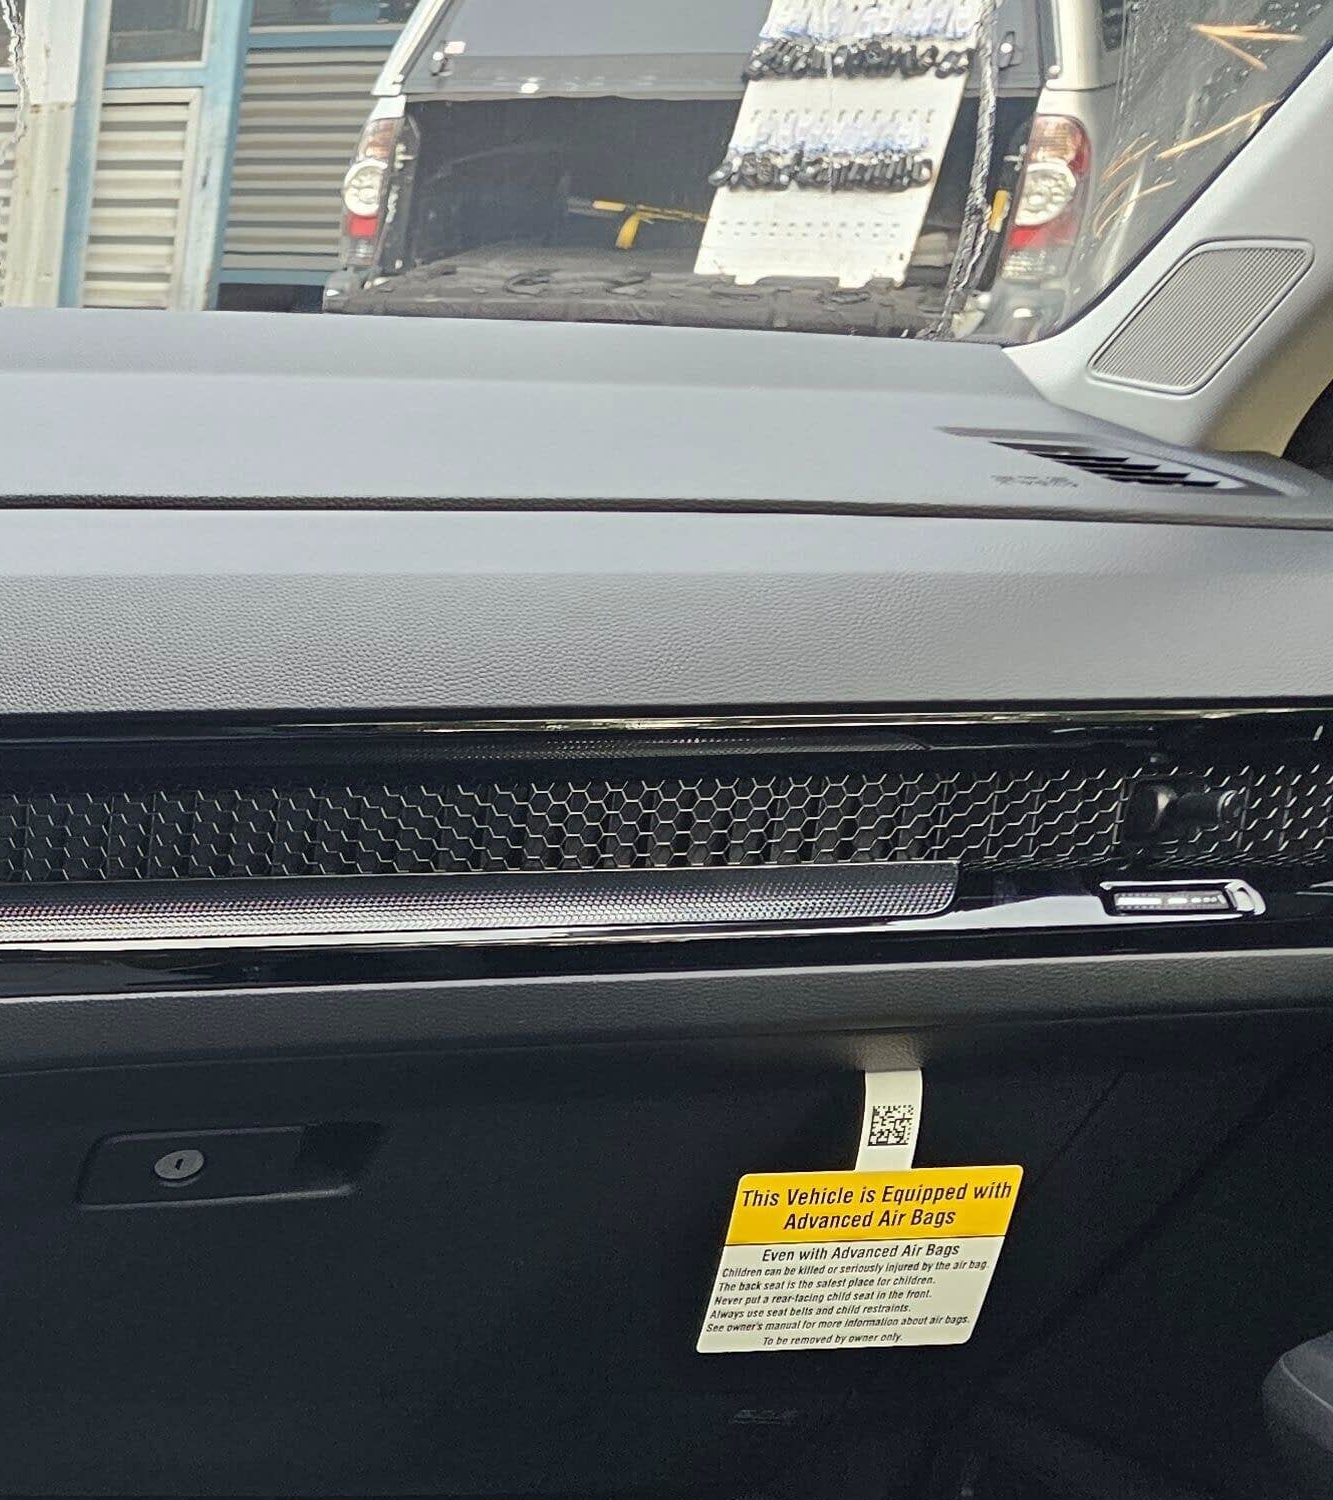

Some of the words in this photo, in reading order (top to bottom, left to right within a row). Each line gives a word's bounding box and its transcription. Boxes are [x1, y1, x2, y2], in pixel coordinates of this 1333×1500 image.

[742, 1189, 780, 1207] This
[787, 1187, 854, 1206] Vehicle
[860, 1186, 877, 1203] is
[882, 1183, 969, 1205] Equipped
[974, 1181, 1013, 1199] with
[783, 1211, 874, 1230] Advanced
[878, 1210, 906, 1227] Air
[910, 1209, 957, 1228] Bags
[762, 1249, 795, 1262] Even
[799, 1248, 828, 1260] with
[831, 1245, 899, 1259] Advanced
[901, 1244, 923, 1257] Air
[925, 1244, 961, 1258] Bags
[722, 1267, 762, 1278] Children
[784, 1266, 796, 1276] be
[798, 1265, 825, 1275] killed
[827, 1266, 837, 1274] or
[840, 1262, 884, 1273] seriously
[885, 1262, 920, 1273] injured
[922, 1261, 933, 1272] by
[935, 1261, 951, 1270] the
[953, 1260, 967, 1270] air
[968, 1260, 989, 1271] bag.
[718, 1282, 736, 1292] The
[738, 1281, 761, 1291] back
[763, 1280, 784, 1290] seat
[786, 1280, 796, 1289] is
[798, 1280, 814, 1289] the
[816, 1278, 846, 1288] safest
[847, 1276, 874, 1289] place
[876, 1276, 891, 1286] for
[892, 1275, 936, 1286] children.
[714, 1296, 744, 1306] Never
[744, 1295, 761, 1306] put
[762, 1296, 769, 1304] a
[771, 1293, 824, 1305] rear-facing
[826, 1292, 851, 1301] child
[853, 1290, 874, 1300] seat
[876, 1290, 886, 1300] in
[888, 1289, 904, 1299] the
[906, 1288, 932, 1298] front.
[709, 1309, 745, 1320] Always
[746, 1310, 765, 1318] use
[766, 1307, 788, 1317] seat
[790, 1306, 814, 1317] belts
[815, 1306, 834, 1315] and
[836, 1305, 860, 1314] child
[862, 1303, 911, 1313] restraints.
[706, 1322, 725, 1333] See
[726, 1321, 763, 1332] owner's
[764, 1320, 801, 1331] manual
[802, 1319, 817, 1330] for
[818, 1320, 843, 1329] more
[844, 1317, 899, 1328] information
[900, 1315, 928, 1326] about
[928, 1315, 944, 1325] air
[945, 1314, 971, 1326] bags.
[763, 1336, 774, 1346] To
[776, 1335, 788, 1345] be
[790, 1334, 833, 1344] removed
[835, 1333, 846, 1345] by
[848, 1333, 878, 1342] owner
[880, 1332, 903, 1343] only.
